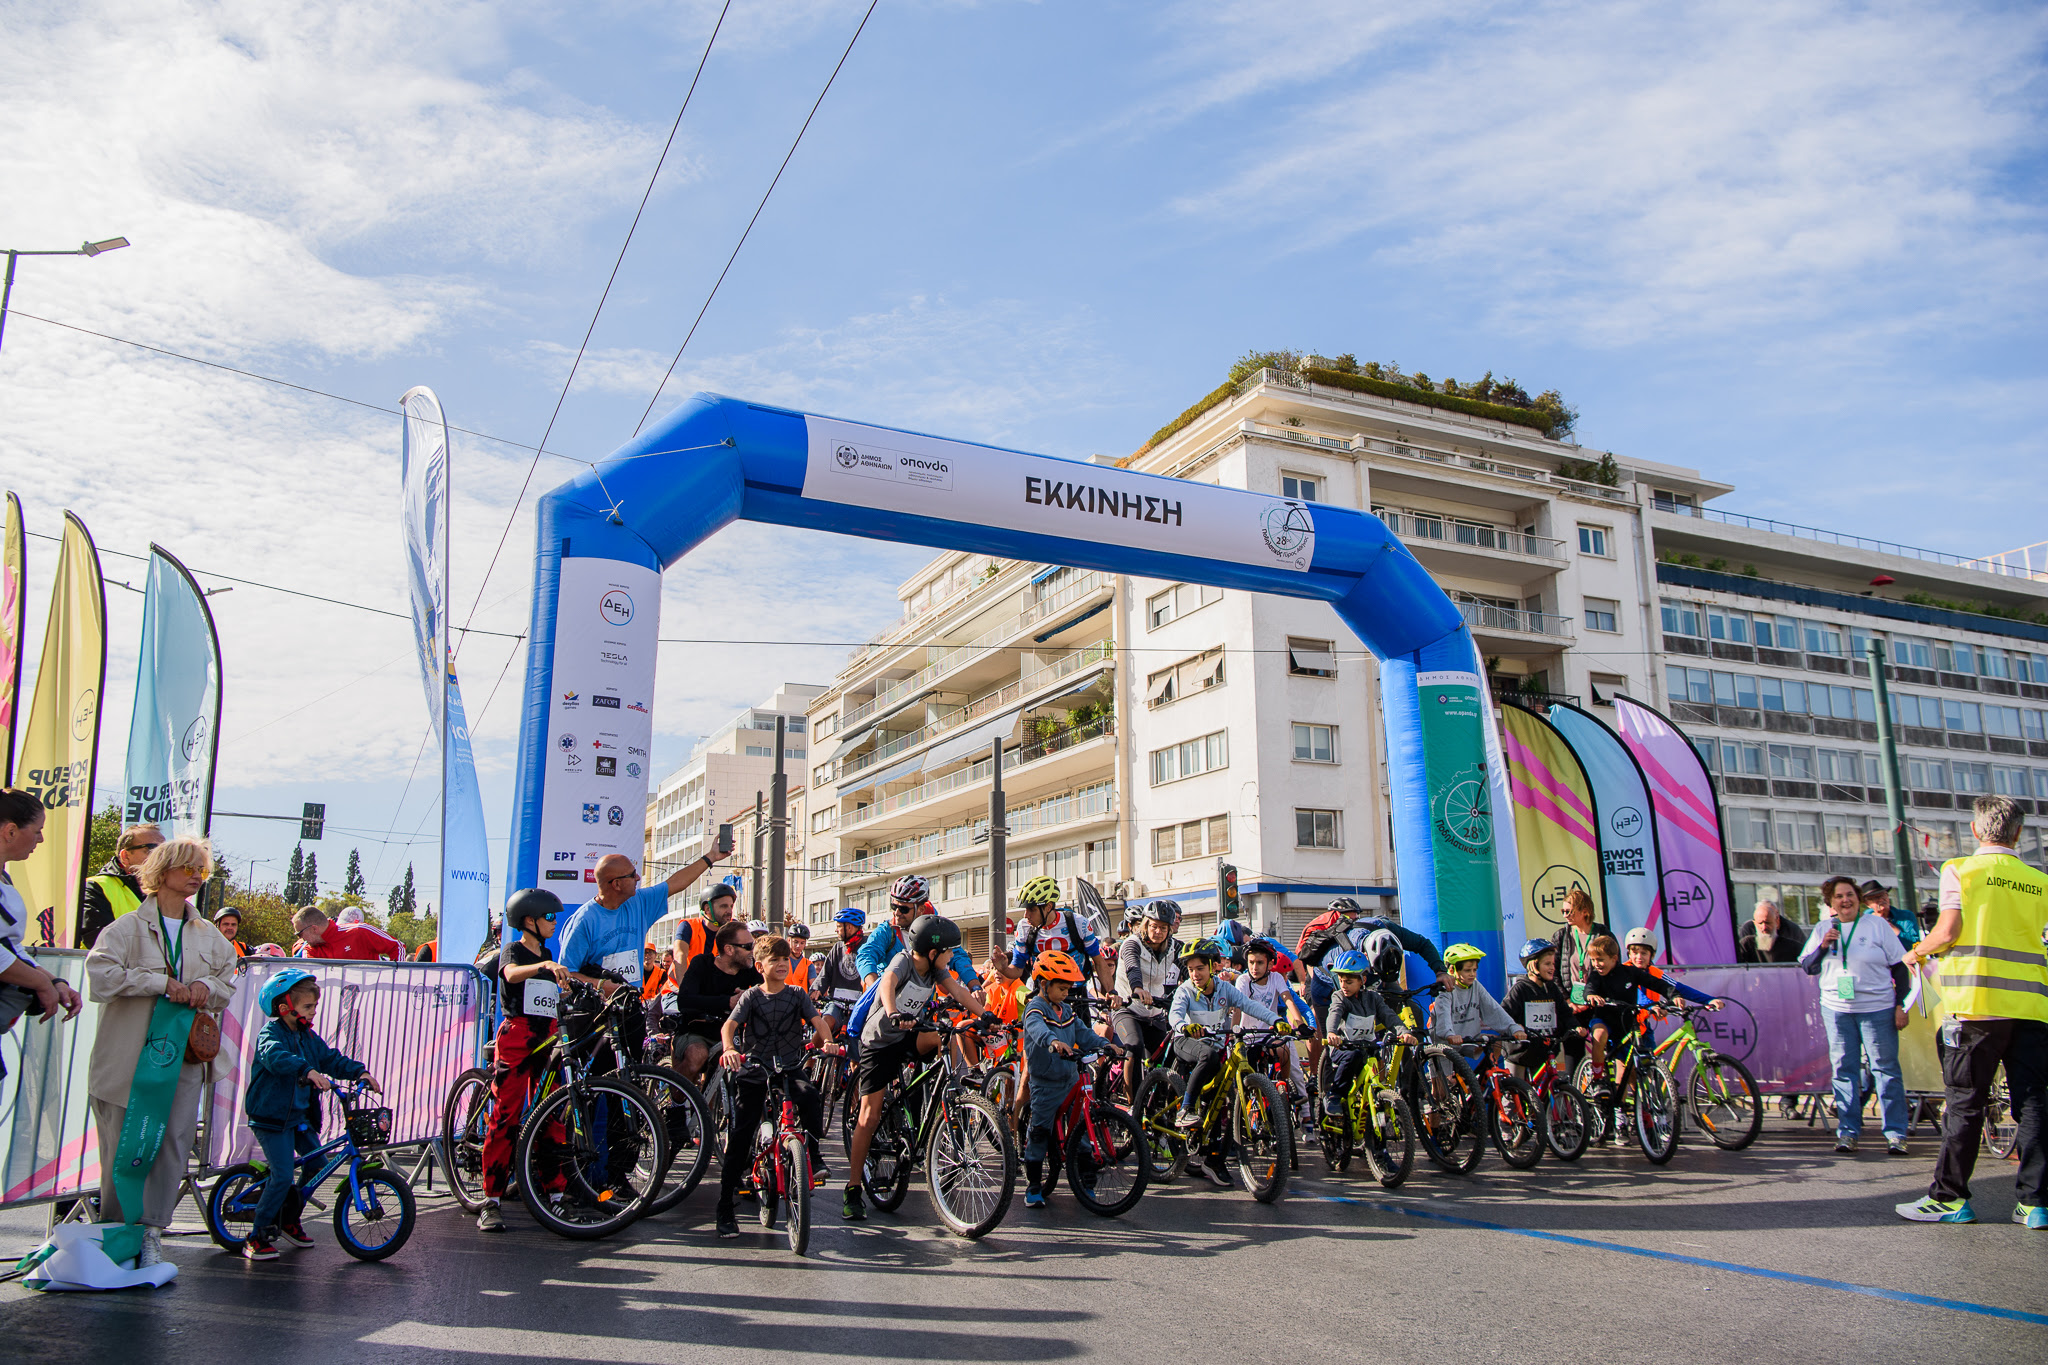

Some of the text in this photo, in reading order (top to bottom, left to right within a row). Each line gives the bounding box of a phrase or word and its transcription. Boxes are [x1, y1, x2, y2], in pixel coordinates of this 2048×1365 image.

[860, 454, 882, 462] ΔΗΜΟΣ
[860, 461, 892, 470] ΑΘΗΝΑΙΩΝ
[1025, 476, 1182, 526] ΕΚΚΙΝΗΣΗ
[604, 599, 630, 618] ΔΕΗ
[601, 652, 628, 661] TESLA
[628, 746, 646, 758] SMITH
[1435, 819, 1477, 856] Ποδηλατικός
[554, 852, 576, 861] ΕΡΤ
[1986, 877, 2042, 896] ΔΙΟΡΓΑΝΩΣΗ
[460, 984, 469, 992] UP
[448, 994, 469, 1005] RIDE
[534, 996, 556, 1008] 6639
[1533, 1014, 1552, 1023] 2429
[1696, 1016, 1747, 1046] ΔΕΗ
